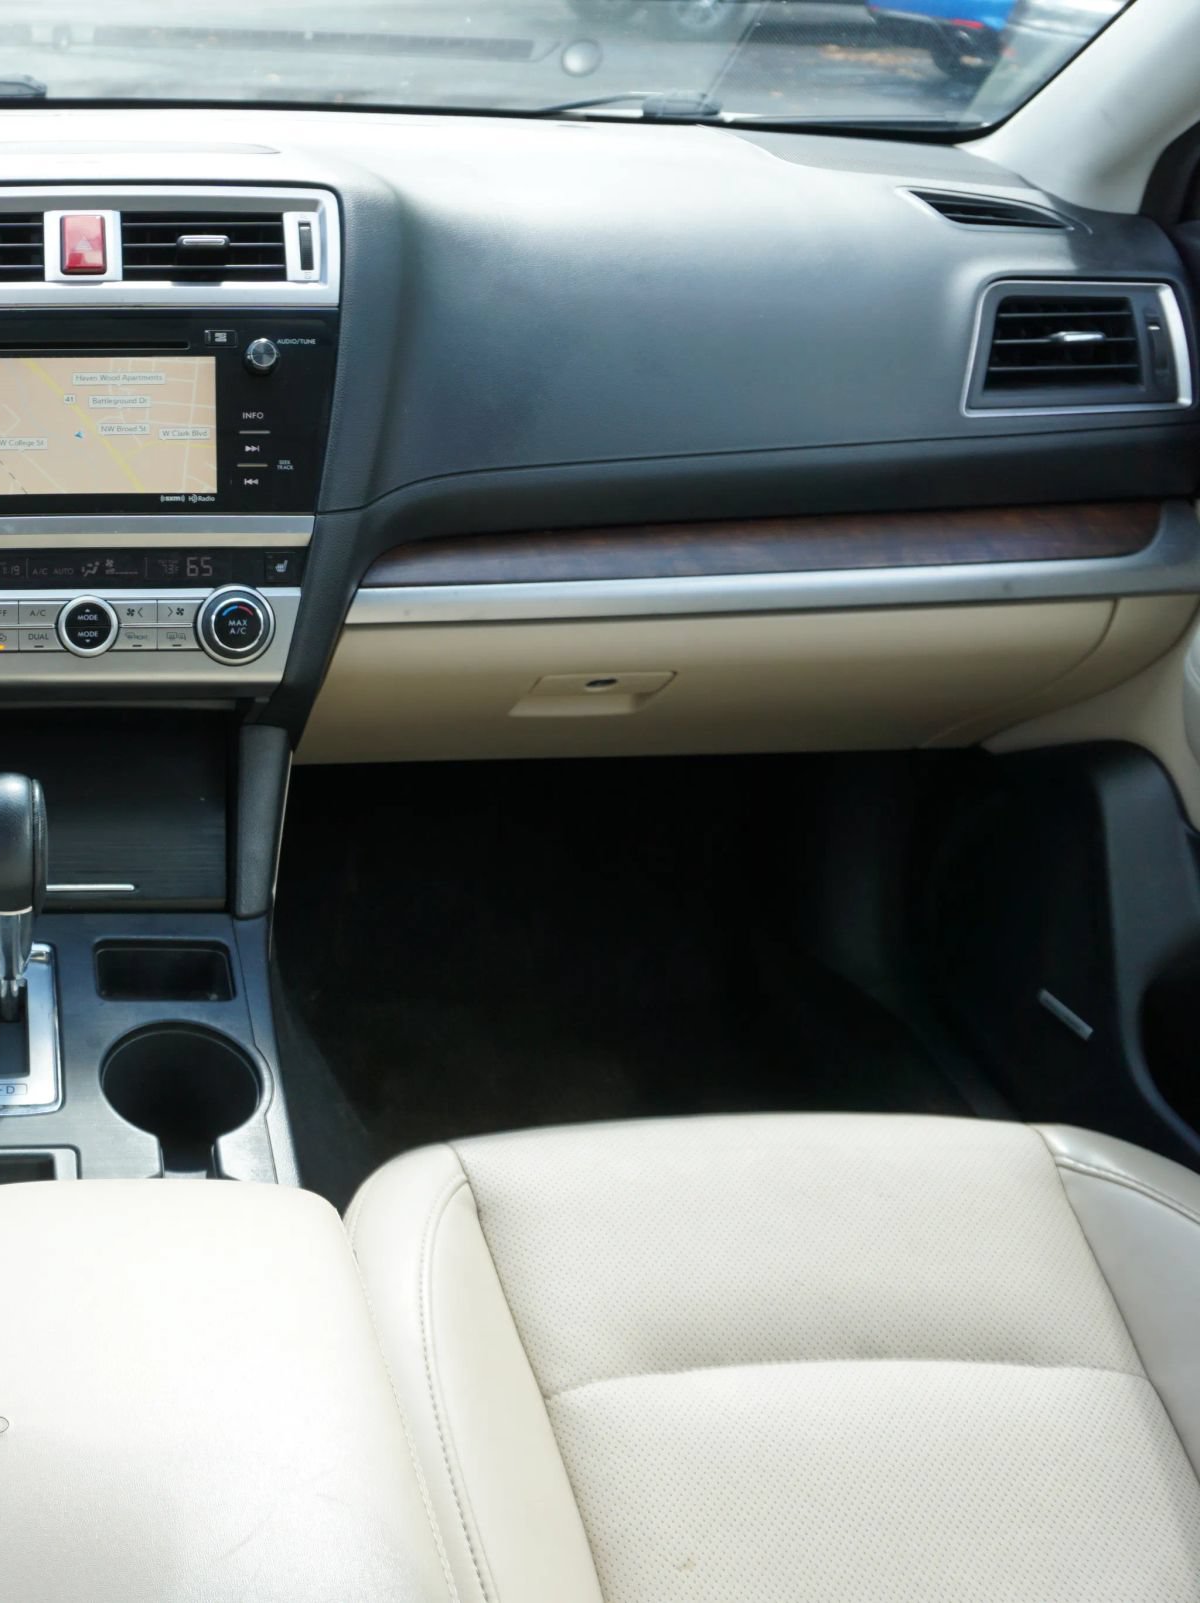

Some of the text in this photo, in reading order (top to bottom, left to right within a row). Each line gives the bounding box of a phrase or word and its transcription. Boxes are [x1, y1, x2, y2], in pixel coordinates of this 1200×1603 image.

[75, 374, 163, 383] Haven Wood Apartments
[92, 397, 136, 405] Battleground
[242, 411, 264, 420] INFO
[8, 439, 35, 447] College
[186, 556, 213, 577] 65
[32, 567, 74, 575] A/C AUTO
[29, 609, 46, 617] A/C
[228, 619, 248, 627] MAX
[77, 630, 99, 638] MODE
[229, 627, 246, 635] A/C
